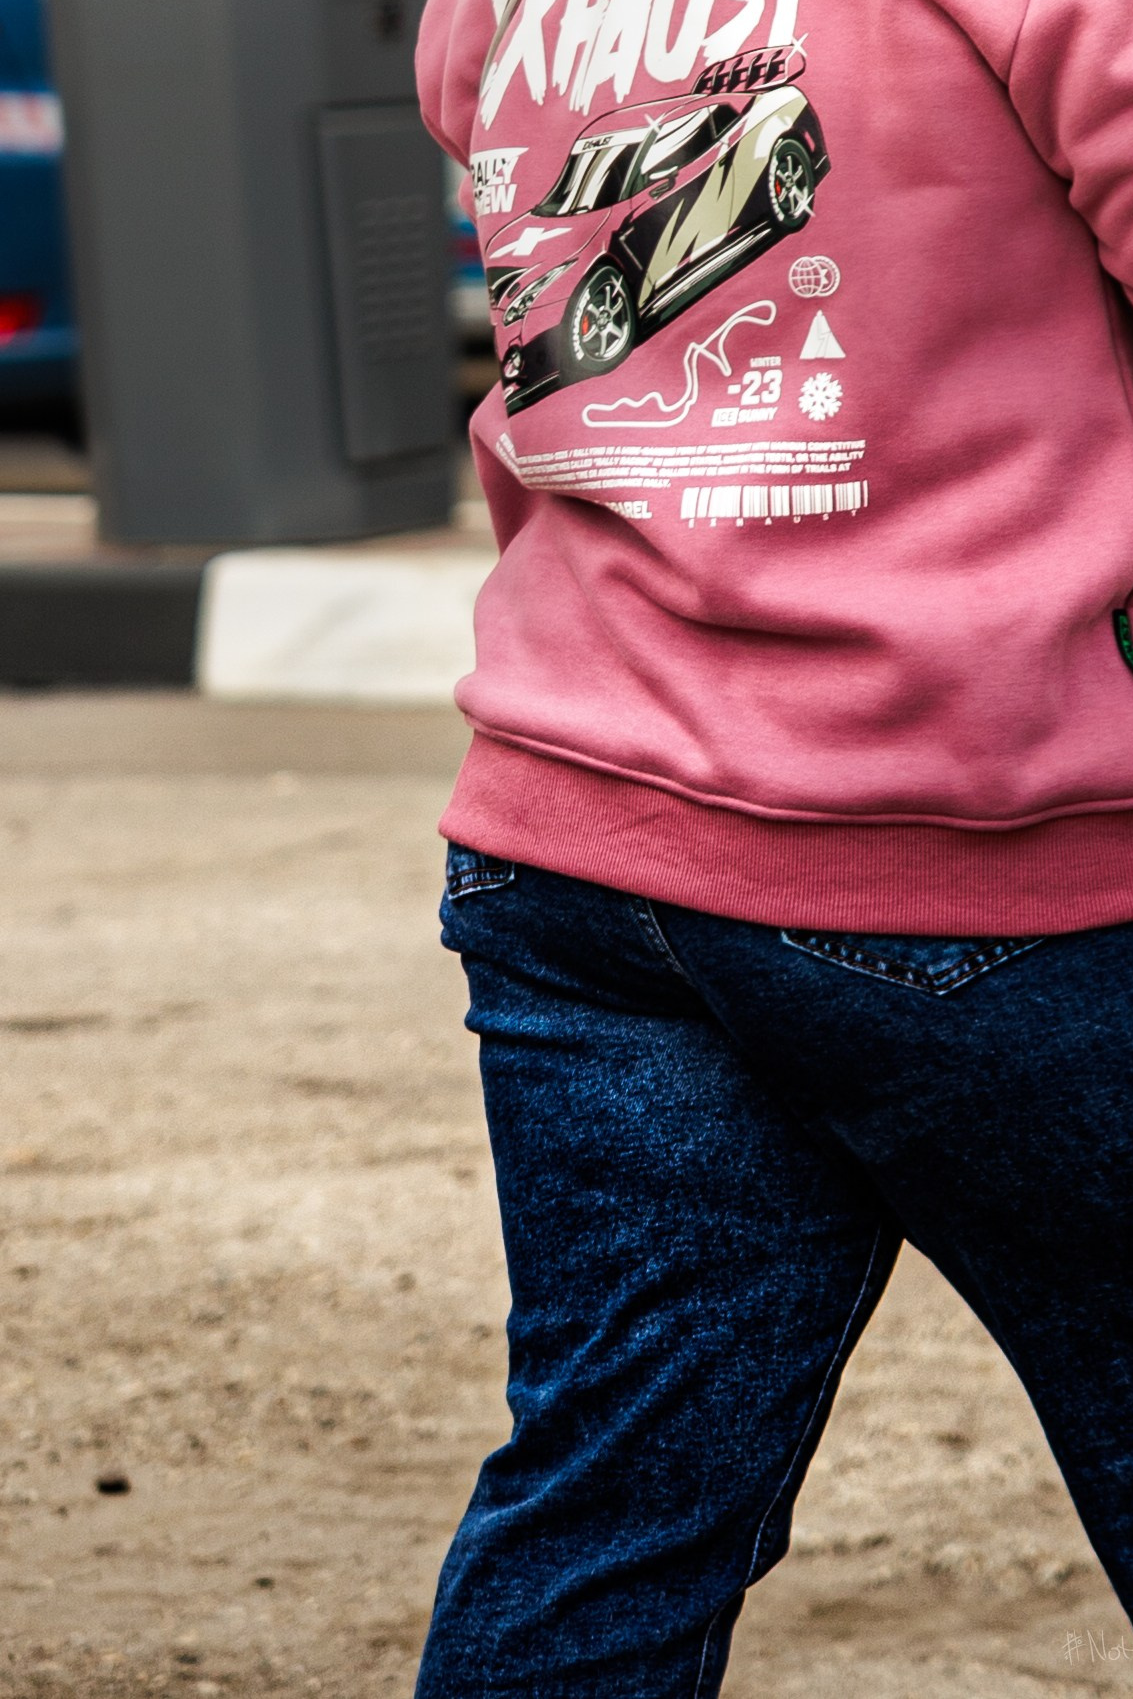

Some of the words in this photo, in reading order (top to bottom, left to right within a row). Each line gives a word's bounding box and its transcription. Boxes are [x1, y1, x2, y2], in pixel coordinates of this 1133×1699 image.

[750, 355, 782, 369] WINTER
[727, 369, 783, 406] -23
[737, 406, 779, 424] SUNNY
[809, 452, 828, 462] THE
[828, 450, 865, 462] ABILITY
[804, 463, 837, 473] TRIALS
[837, 462, 852, 472] AT
[594, 500, 653, 519] PAREL
